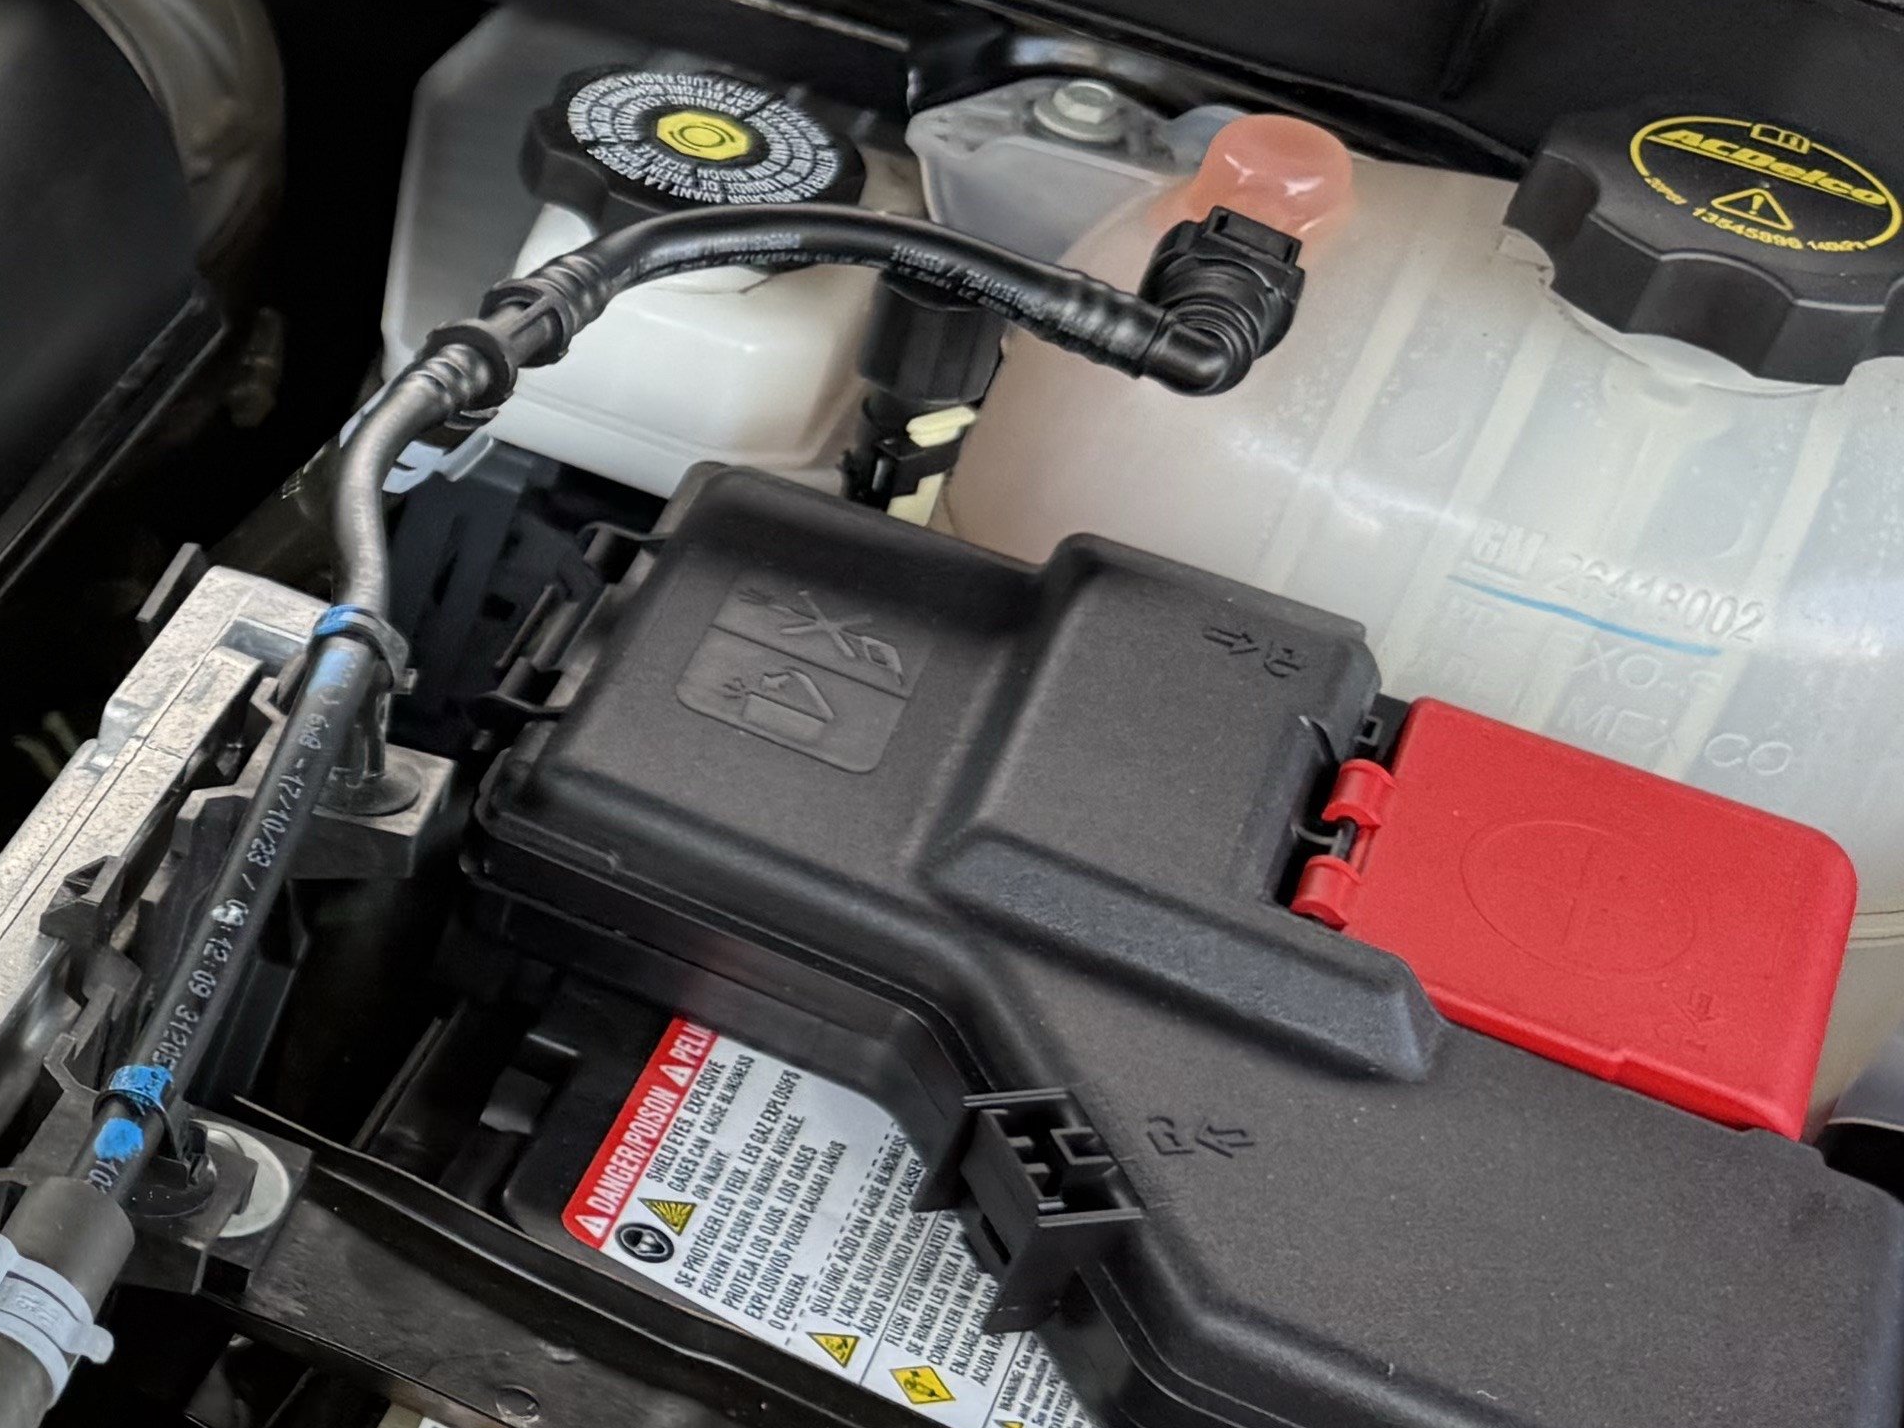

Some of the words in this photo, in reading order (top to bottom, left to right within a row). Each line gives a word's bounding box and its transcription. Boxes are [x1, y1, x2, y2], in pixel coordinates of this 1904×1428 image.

[1656, 129, 1887, 207] ACDelco
[759, 1067, 802, 1126] EXPLOSIFS
[586, 1081, 680, 1218] DANGER/POISON
[668, 1019, 714, 1067] PELI
[644, 1142, 680, 1185] SHIELD
[665, 1111, 697, 1147] EYES.
[682, 1057, 726, 1116] EXPLOSIVE
[667, 1155, 700, 1194] GASES
[686, 1134, 711, 1159] CAN
[699, 1100, 730, 1136] CAUSE
[715, 1052, 755, 1106] BLINDNESS
[748, 1120, 773, 1146] GAZ
[769, 1109, 806, 1159] AVEUGLE.
[699, 1146, 731, 1187] INJURY.
[738, 1141, 762, 1166] LES
[786, 1142, 818, 1182] GASES
[691, 1182, 712, 1201] OR
[721, 1161, 752, 1197] YEUX.
[750, 1154, 783, 1197] RENDRE
[774, 1177, 800, 1205] LOS
[710, 1193, 735, 1218] LES
[742, 1192, 764, 1212] OU
[758, 1200, 789, 1237] OJOS.
[857, 1182, 886, 1218] CAUSE
[677, 1211, 725, 1274] PROTÉGER
[720, 1207, 756, 1255] BLESSER
[847, 1213, 871, 1239] CAN
[743, 1248, 792, 1321] EXPLOSIVOS
[778, 1210, 811, 1253] PUEDEN
[798, 1172, 830, 1214] CAUSAR
[746, 1233, 772, 1261] LOS
[832, 1281, 866, 1328] L'ACIDE
[852, 1216, 898, 1287] SULFURIQUE
[883, 1193, 908, 1221] PEUT
[834, 1234, 861, 1266] ACID
[910, 1220, 952, 1287] IMMEDIATELY
[673, 1269, 695, 1289] SE
[697, 1251, 734, 1300] PEUVENT
[720, 1255, 762, 1311] PROTEJA
[808, 1261, 848, 1318] SULFURIC
[937, 1259, 961, 1287] YEUX
[899, 1284, 924, 1313] EYES
[928, 1283, 950, 1307] LES
[883, 1311, 912, 1348] FLUSH
[911, 1302, 941, 1343] RINSER
[925, 1305, 964, 1367] CONSULTER
[951, 1290, 971, 1309] UN
[905, 1339, 925, 1357] SE
